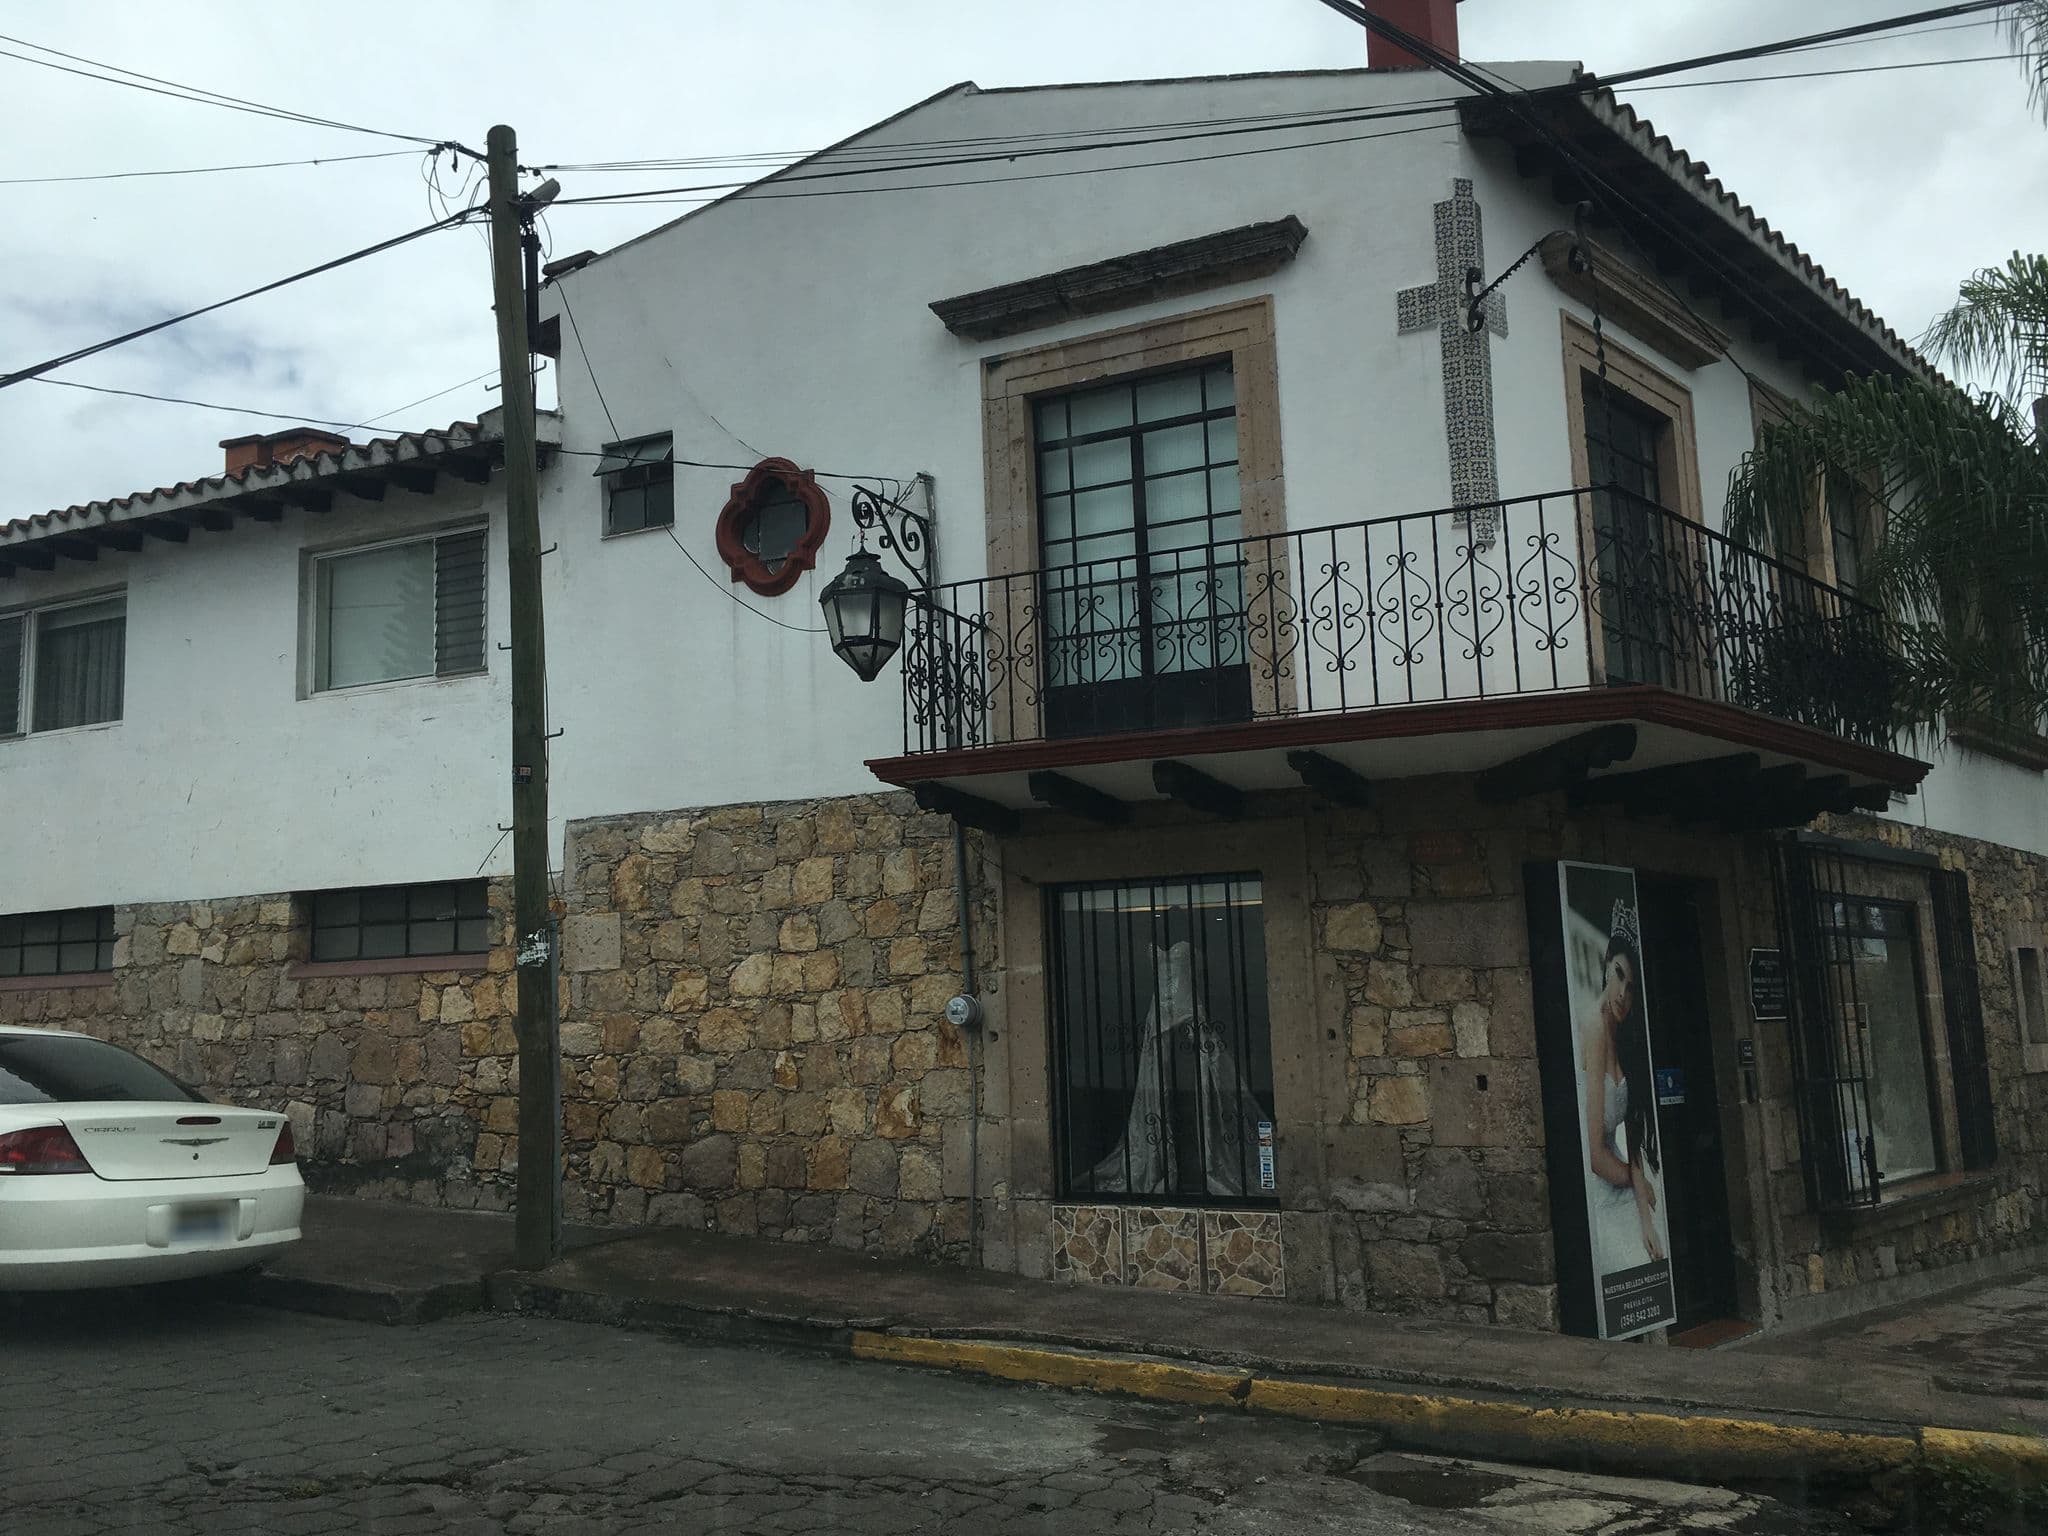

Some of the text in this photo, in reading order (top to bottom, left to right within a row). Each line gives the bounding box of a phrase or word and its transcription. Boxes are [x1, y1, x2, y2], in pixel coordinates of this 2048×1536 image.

[1604, 1284, 1625, 1294] NUESTRA
[1625, 1278, 1644, 1290] BELLEZA
[1624, 1296, 1653, 1310] PREVIA CITA
